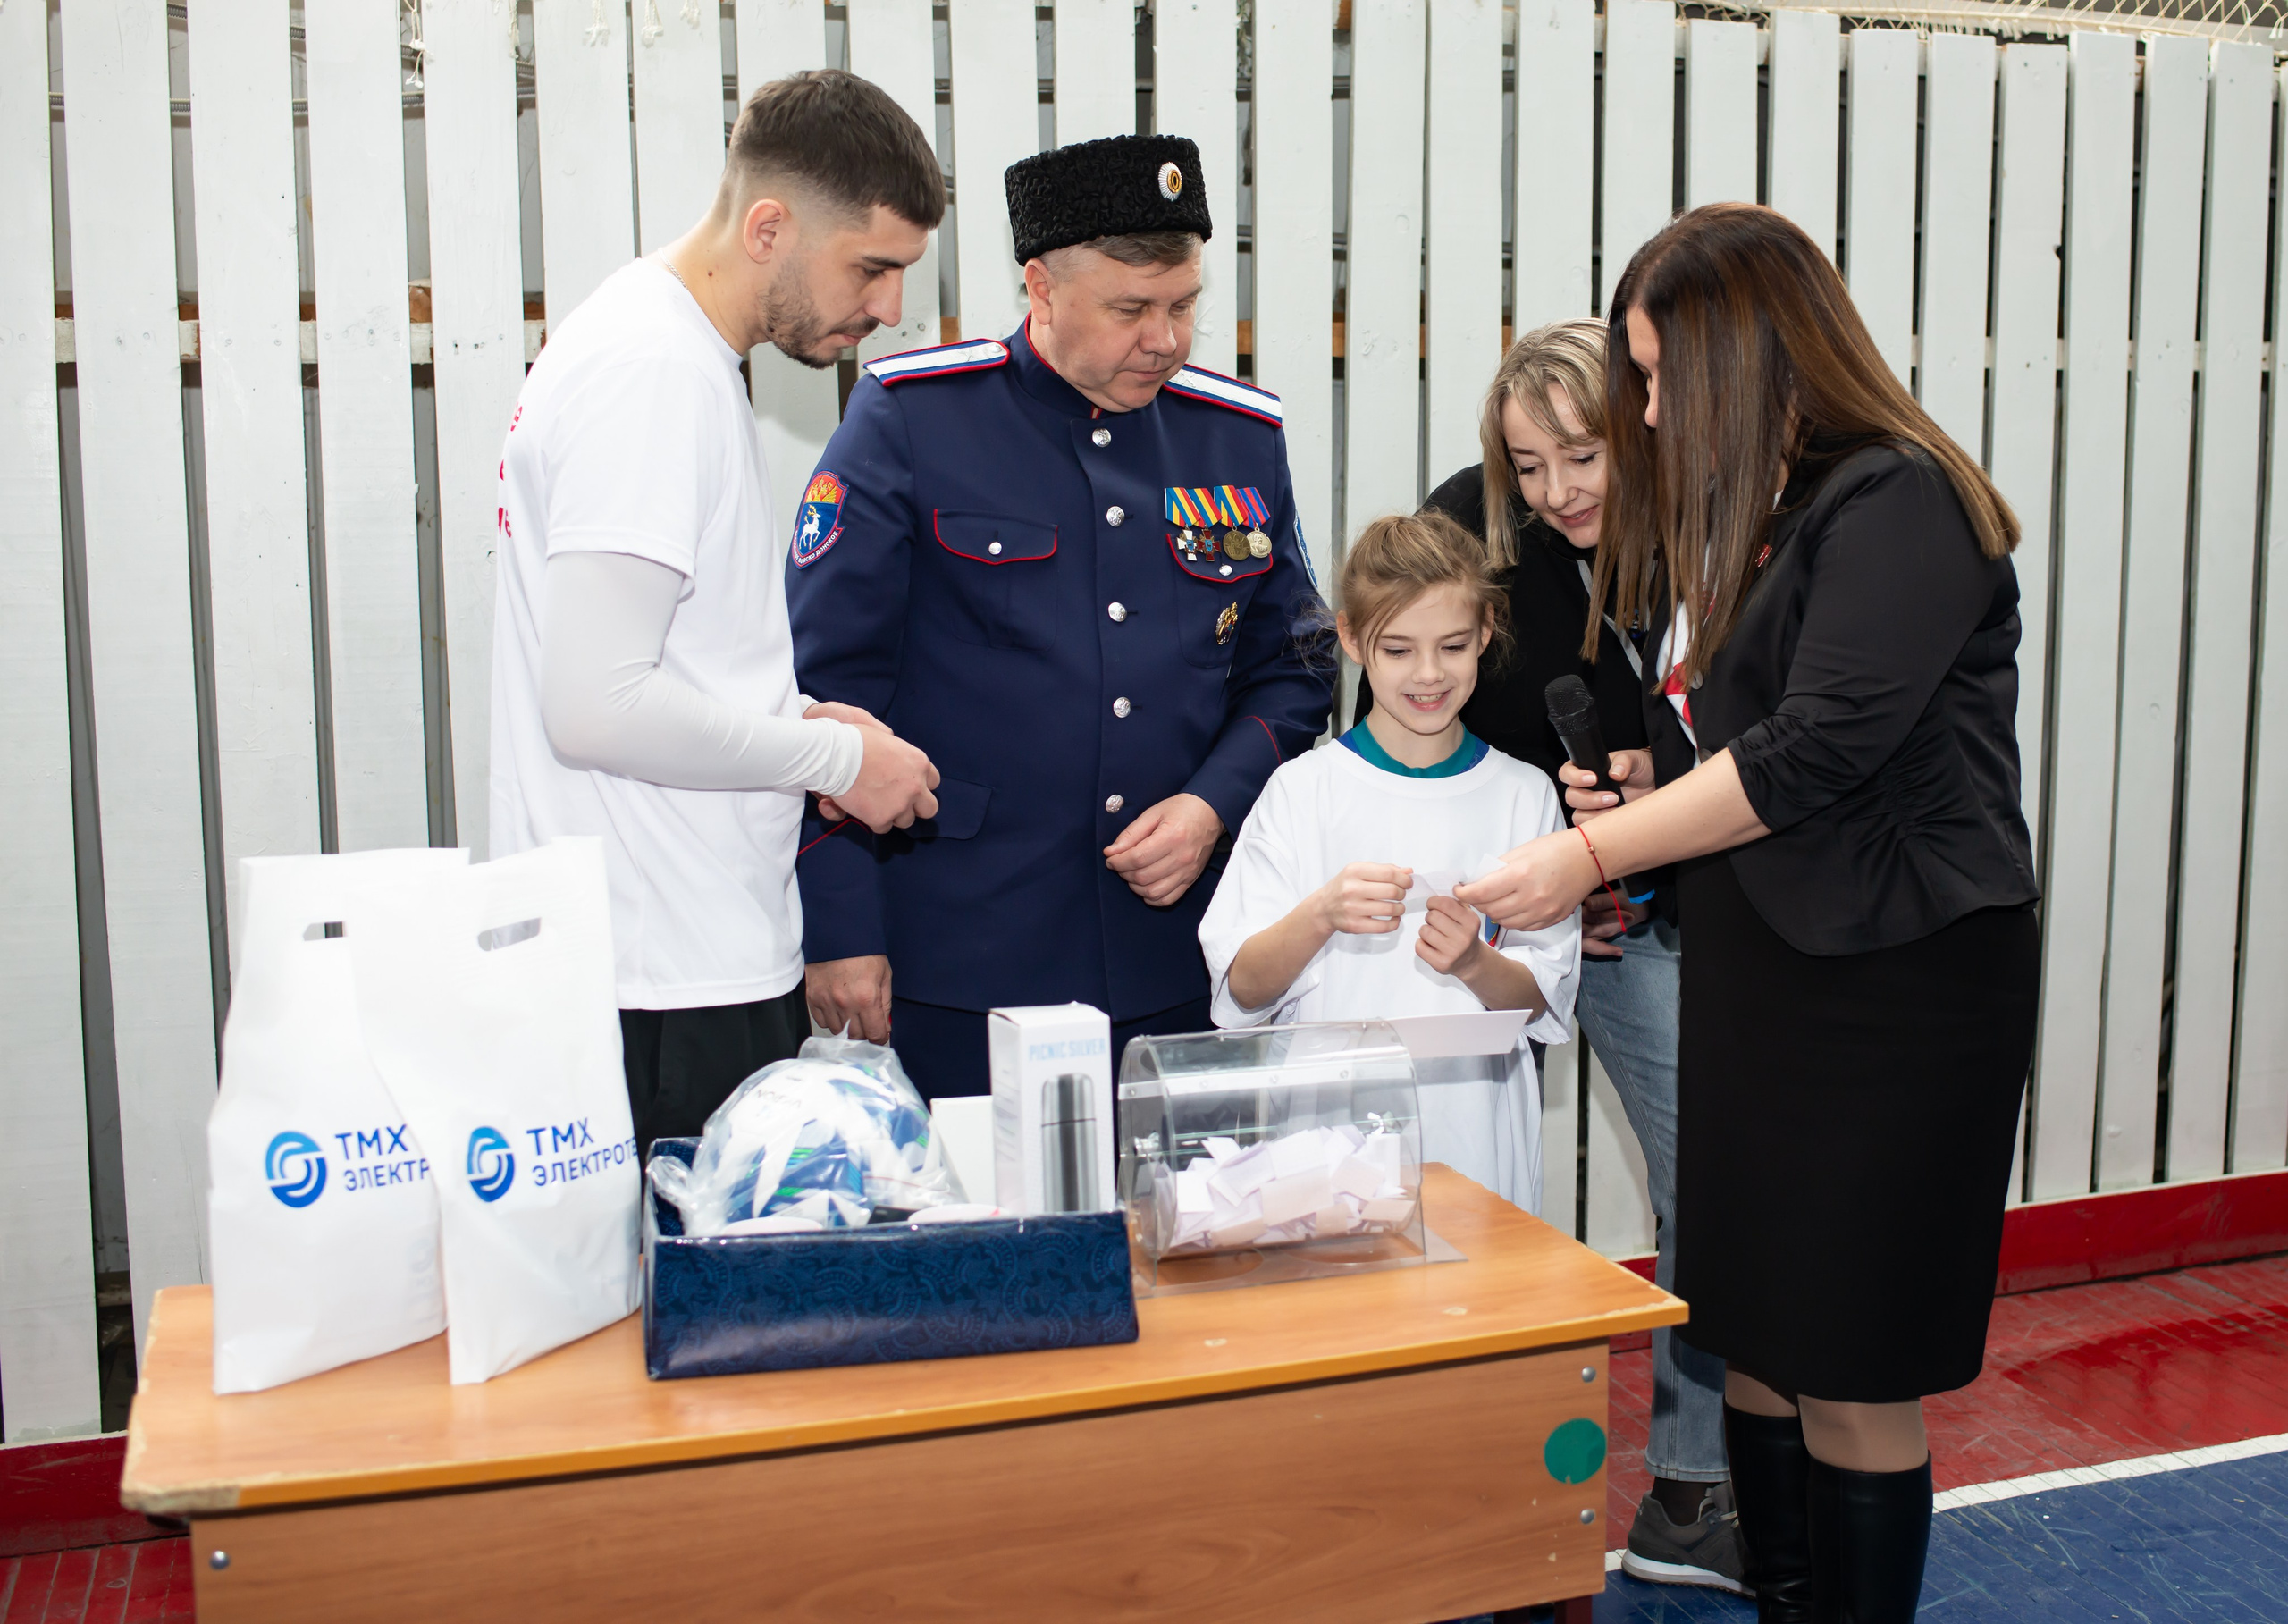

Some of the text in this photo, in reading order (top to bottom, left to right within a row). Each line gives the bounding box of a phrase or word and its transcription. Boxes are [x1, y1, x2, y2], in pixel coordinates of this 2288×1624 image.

[815, 530, 838, 556] ДОНСКОЕ
[1029, 1038, 1106, 1061] PICNIC SILVER
[334, 1123, 408, 1160] ТМХ
[526, 1116, 594, 1156] ТМХ
